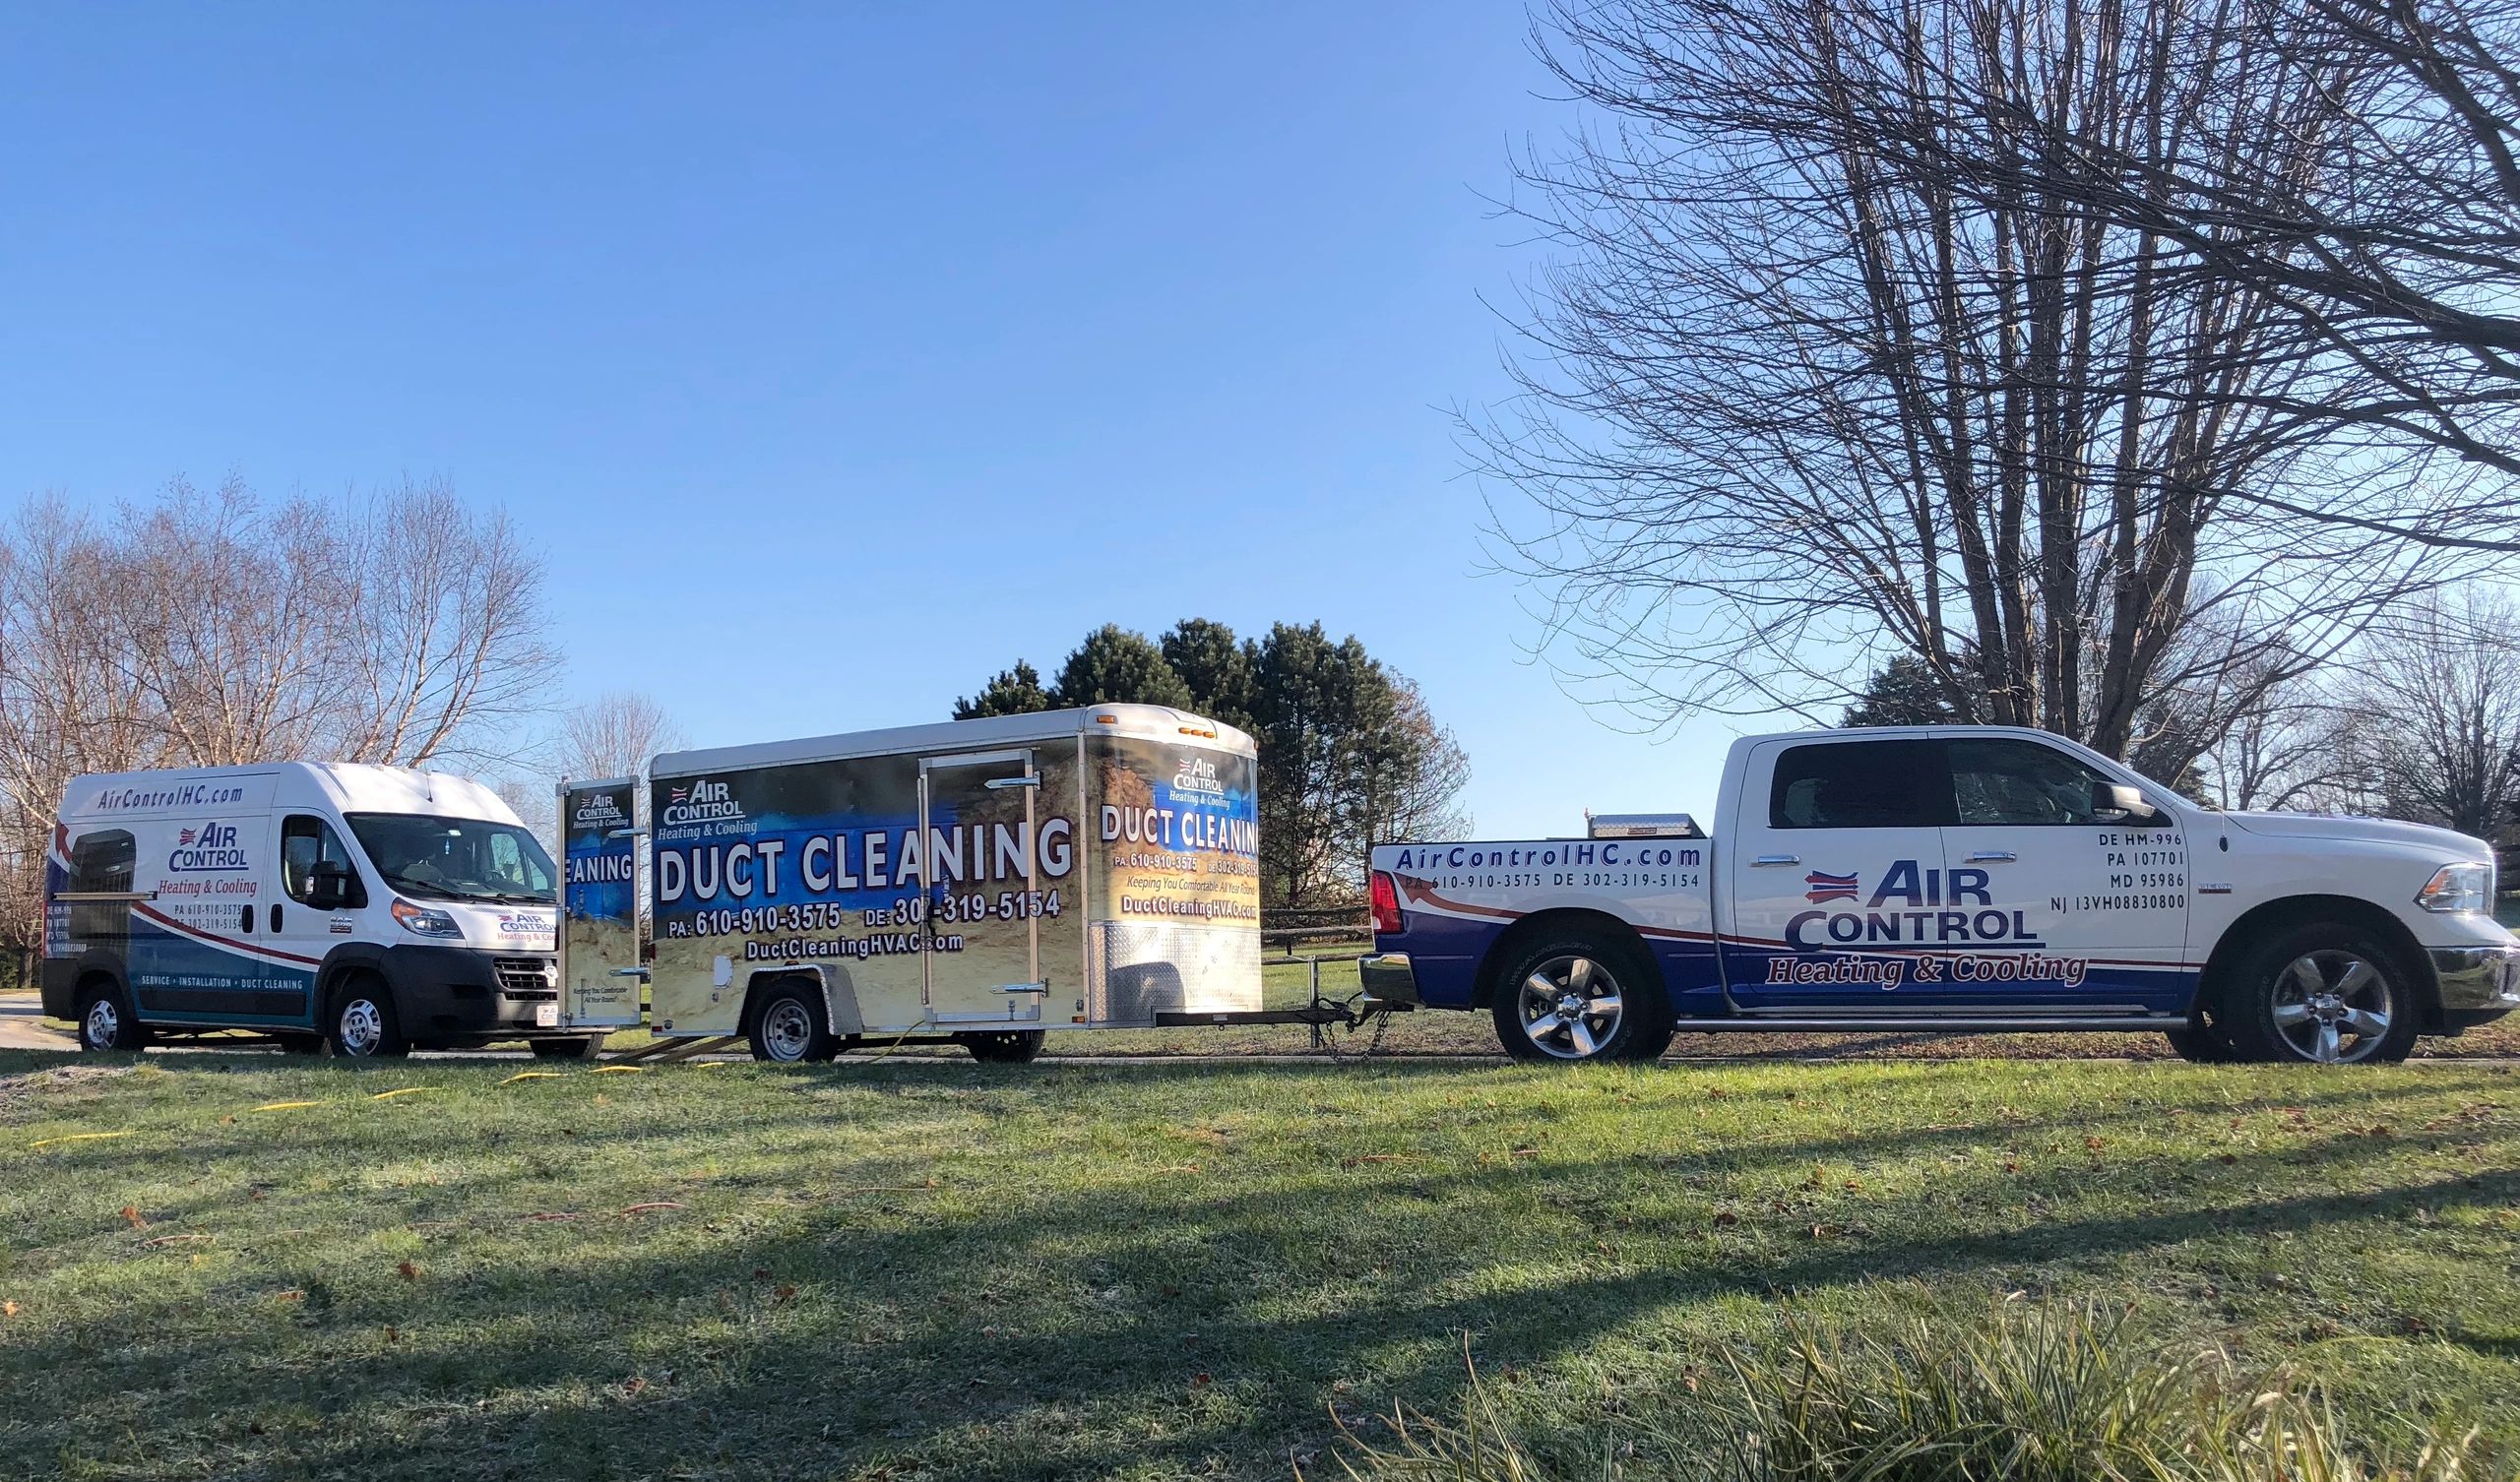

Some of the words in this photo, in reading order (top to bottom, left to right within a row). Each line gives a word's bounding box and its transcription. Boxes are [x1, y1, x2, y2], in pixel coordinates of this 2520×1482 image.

[1191, 758, 1216, 778] AIR
[689, 779, 729, 804] AIR
[1173, 773, 1224, 792] CONTROL
[97, 784, 242, 810] AirControlHC.com
[591, 794, 613, 808] AIR
[1169, 790, 1199, 806] Heating
[1200, 794, 1207, 805] &
[1207, 795, 1230, 811] Cooling
[576, 807, 621, 821] CONTROL
[605, 818, 629, 827] Cooling
[663, 800, 743, 826] CONTROL
[658, 827, 701, 841] Heating
[704, 824, 713, 836] &
[716, 820, 758, 835] Cooling
[1102, 804, 1173, 844] DUCT
[197, 822, 237, 848] AIR
[2099, 834, 2118, 846] DE
[2125, 834, 2181, 846] HM-996
[168, 849, 248, 872] CONTROL
[660, 840, 785, 902] DUCT
[802, 819, 1072, 892] CLEANING
[1130, 853, 1197, 871] 610-910-3575
[1394, 843, 1701, 871] AirControlHC.com
[2107, 852, 2126, 867] PA
[2134, 851, 2184, 867] 107701
[158, 879, 201, 897] Heating
[203, 879, 213, 894] &
[216, 878, 257, 897] Cooling
[1127, 876, 1162, 892] Keeping
[1164, 877, 1178, 890] You
[1179, 878, 1219, 893] Comfortable
[1405, 877, 1423, 890] PA
[1431, 874, 1541, 889] 610-910-3575
[1553, 873, 1574, 886] DE
[1583, 873, 1699, 888] 302-319-5154
[1865, 859, 1992, 907] AIR
[2110, 874, 2133, 889] MD
[2140, 873, 2184, 888] 95986
[174, 904, 187, 915] PA
[188, 904, 242, 915] 610-910-3575
[1123, 895, 1257, 919] DuctCleaningHVAC.com
[2050, 896, 2067, 914] NJ
[2076, 894, 2185, 911] 13VH08830800
[517, 914, 545, 923] AIR
[669, 921, 691, 937] PA:
[696, 902, 841, 935] 610-910-3575
[865, 909, 891, 926] DE:
[497, 933, 532, 942] Heating
[1785, 910, 2038, 952] CONTROL
[748, 933, 964, 958] DuctCleaningHVAC.com
[1765, 955, 1905, 990] Heating
[1913, 954, 1944, 982] &
[1951, 952, 2089, 989] Cooling
[142, 975, 170, 985] SERVICE
[179, 976, 231, 987] INSTALLATION
[241, 978, 261, 988] DUCT
[264, 979, 303, 990] CLEANING
